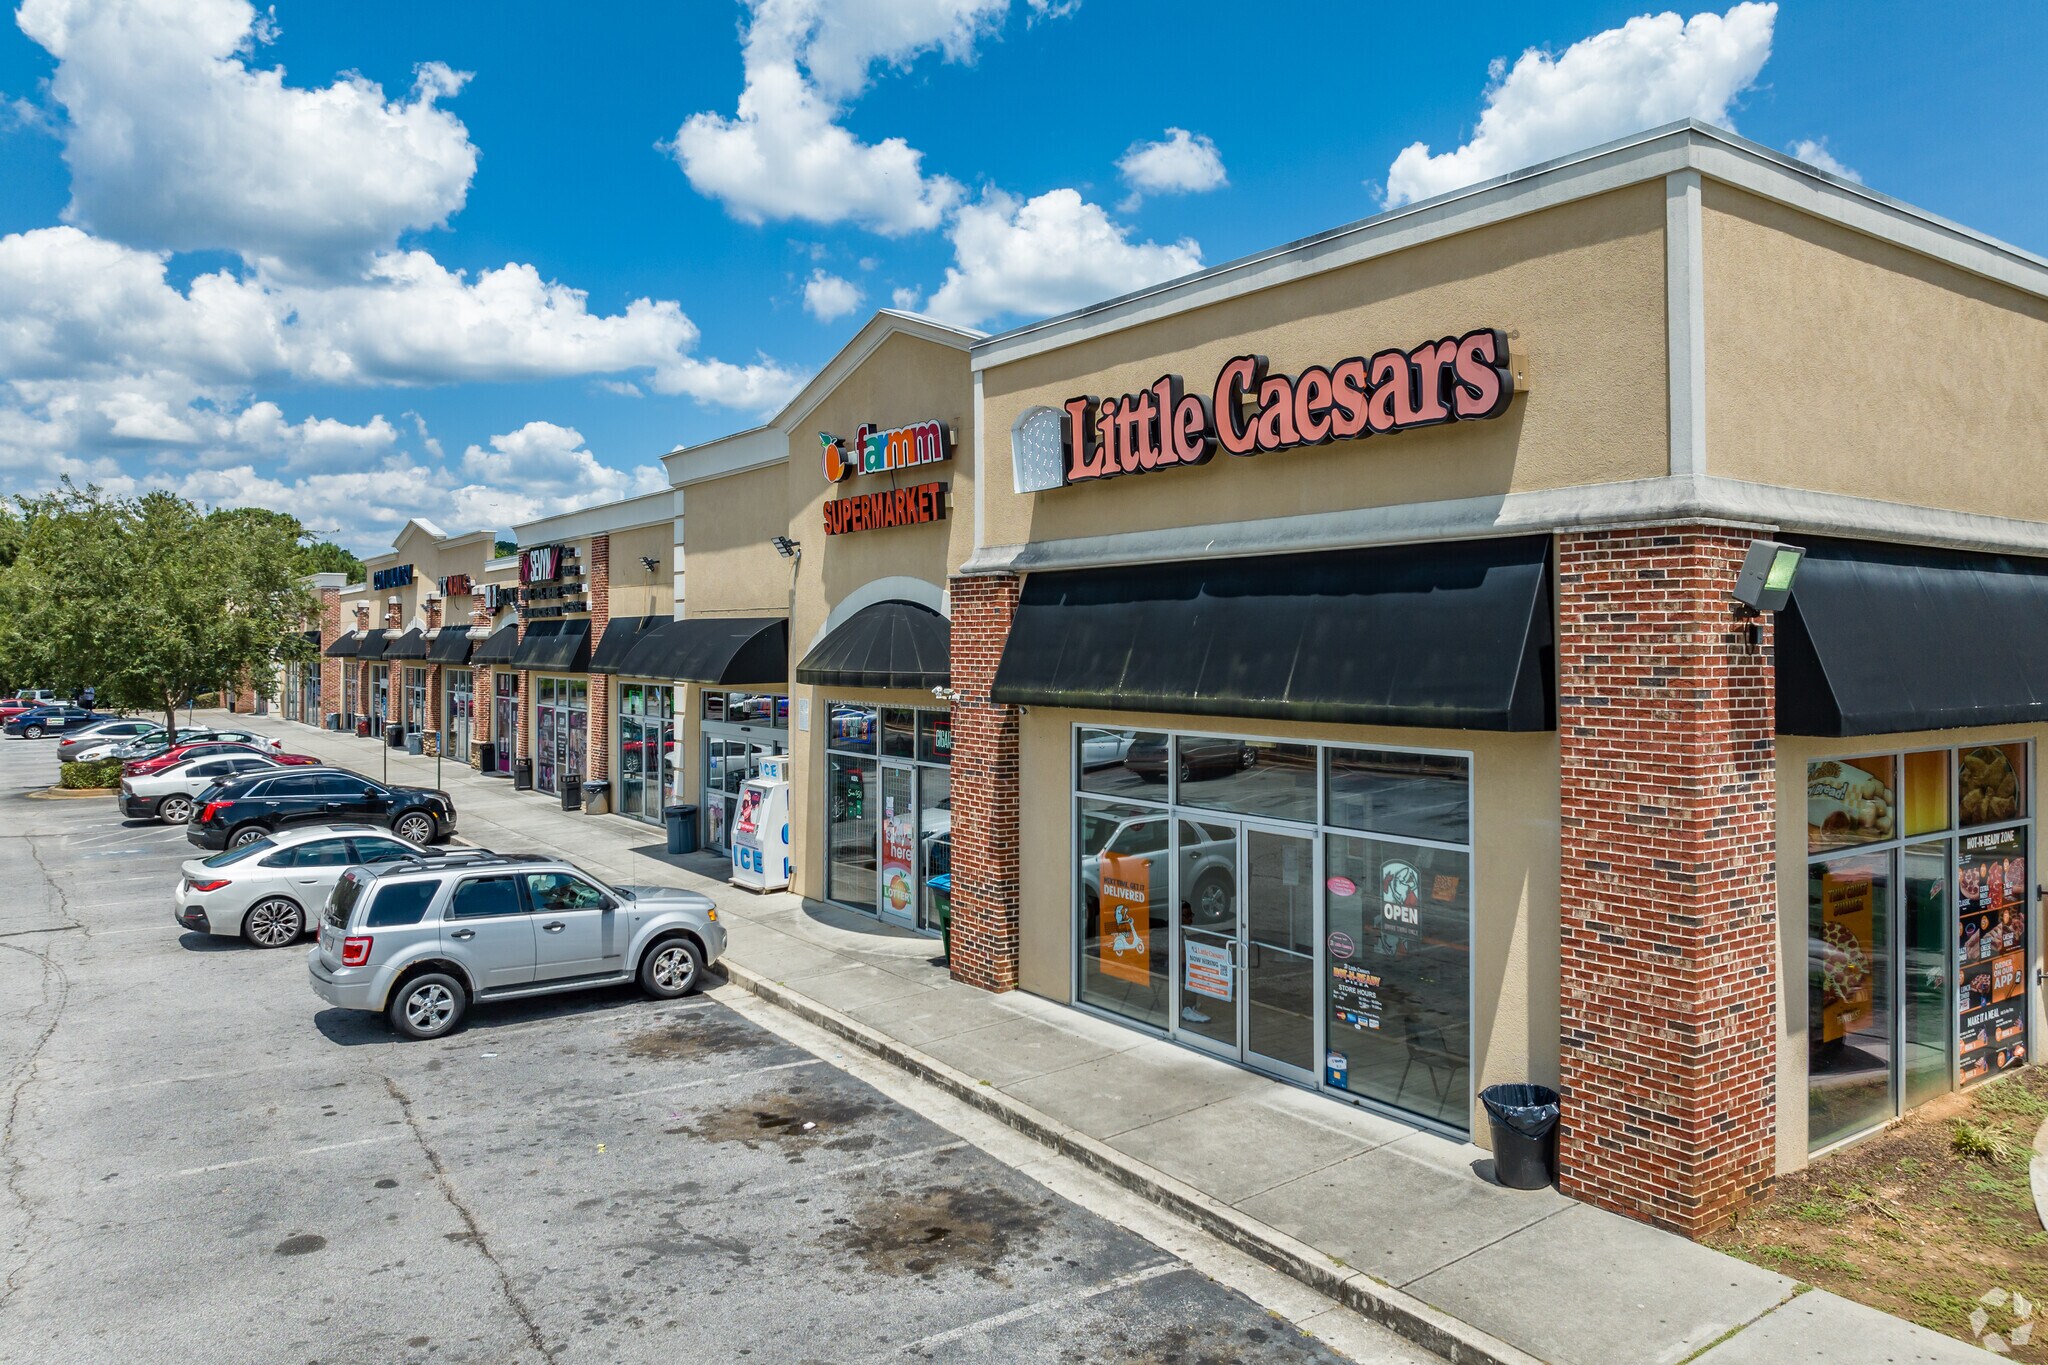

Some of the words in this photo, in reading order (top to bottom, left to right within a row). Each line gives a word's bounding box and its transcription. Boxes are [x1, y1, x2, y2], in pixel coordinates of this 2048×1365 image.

[1064, 375, 1212, 482] Little
[1213, 328, 1512, 457] Caesars
[855, 419, 946, 475] farmm
[823, 482, 946, 535] SUPERMARKET
[760, 762, 777, 777] ICE
[1814, 781, 1849, 800] Bread!
[1967, 833, 2000, 850] HOT-N-READY
[2001, 830, 2015, 843] ZONE
[733, 845, 763, 874] ICE
[890, 845, 912, 861] here
[1103, 884, 1145, 903] DELIVERED
[1384, 903, 1418, 925] OPEN
[1995, 959, 2013, 970] ORDER
[2002, 966, 2013, 975] OUR
[1994, 973, 2013, 989] APP
[1338, 984, 1356, 994] STORE
[1357, 989, 1377, 999] HOURS
[1967, 1014, 1979, 1027] MAKE
